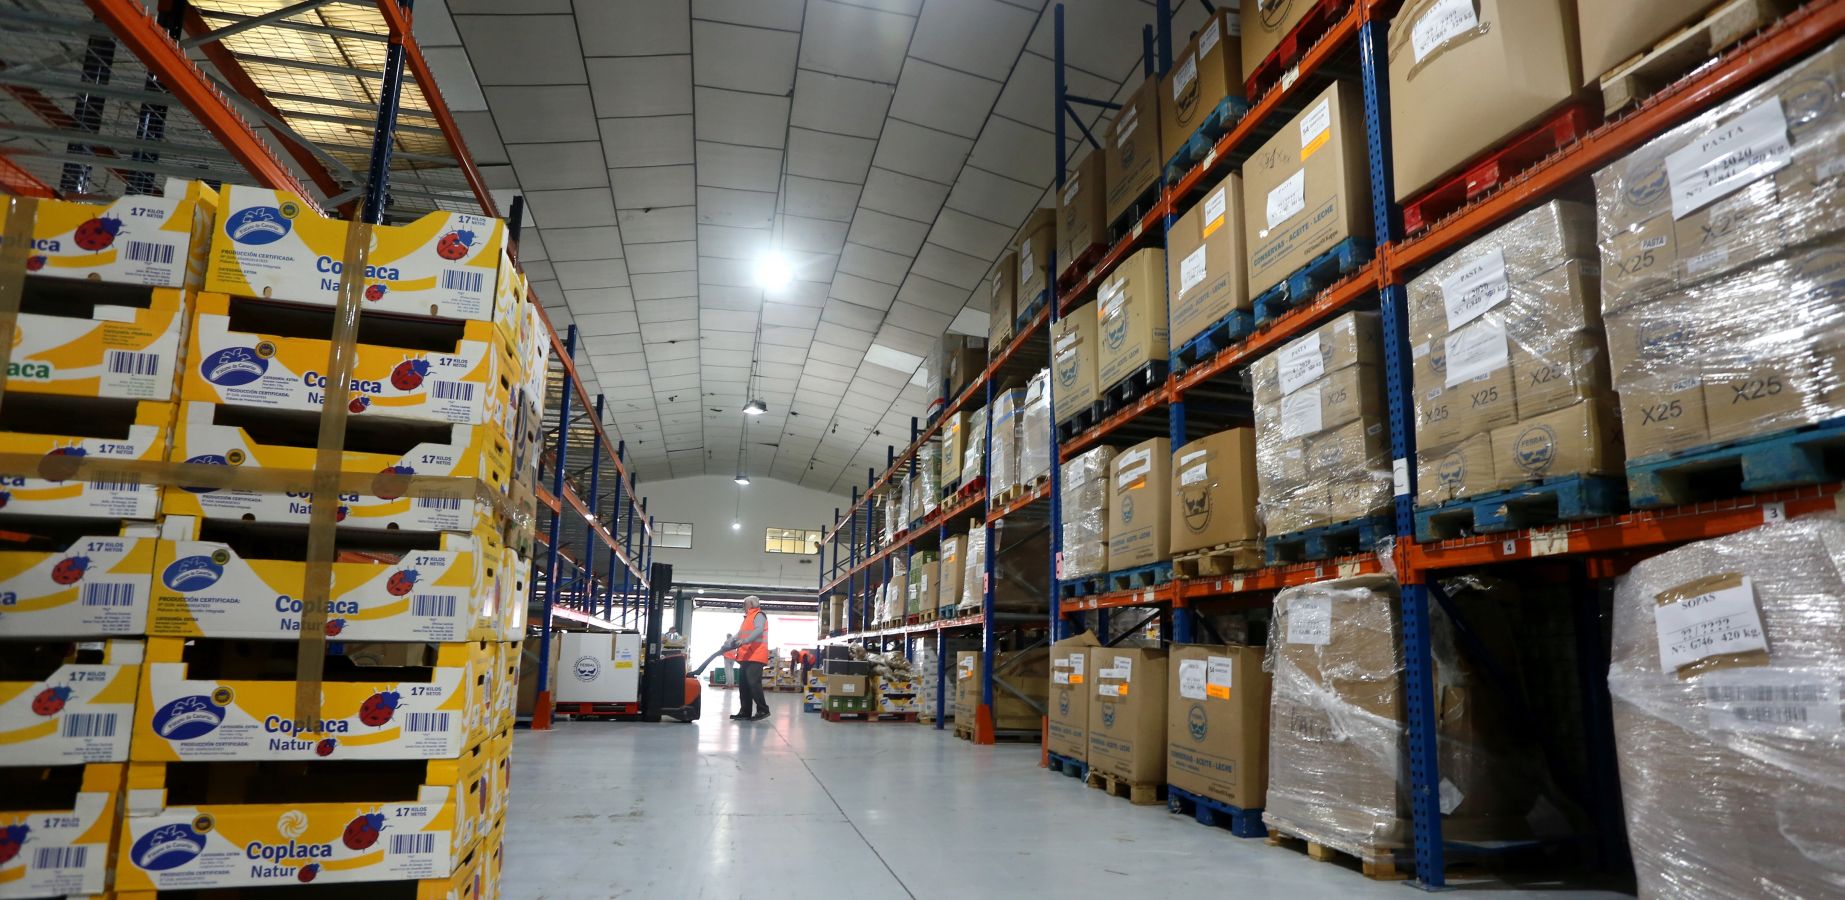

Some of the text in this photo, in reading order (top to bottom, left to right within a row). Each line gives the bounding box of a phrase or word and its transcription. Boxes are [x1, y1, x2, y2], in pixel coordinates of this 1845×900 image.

[1702, 126, 1744, 152] PASTA
[1723, 148, 1752, 170] 2020
[130, 207, 146, 217] 17
[458, 215, 471, 224] 17
[1289, 222, 1309, 241] ACEITE
[1314, 204, 1333, 224] LECHE
[221, 249, 295, 262] PRODUCCIÓN CERTIFICADA:
[1617, 252, 1654, 278] X25
[1460, 266, 1483, 282] PASTA
[439, 358, 453, 366] 17
[1732, 375, 1782, 404] X25
[1328, 388, 1347, 406] X25
[1472, 386, 1498, 408] X25
[1425, 406, 1448, 424] X25
[1642, 400, 1682, 425] X25
[99, 444, 115, 453] 17
[422, 455, 435, 464] 17
[1770, 507, 1778, 518] 3
[88, 542, 104, 552] 17
[1507, 543, 1512, 552] 4
[415, 557, 429, 566] 17
[1682, 592, 1716, 609] SOPAS
[1690, 637, 1713, 650] G746
[1721, 631, 1740, 642] 420
[70, 672, 86, 681] 17
[411, 687, 425, 696] 17
[265, 716, 348, 737] Coplaca
[269, 738, 313, 750] Natur
[396, 808, 410, 817] 17
[44, 818, 60, 828] 17
[246, 840, 332, 863] Coplaca
[251, 866, 296, 878] Natur
